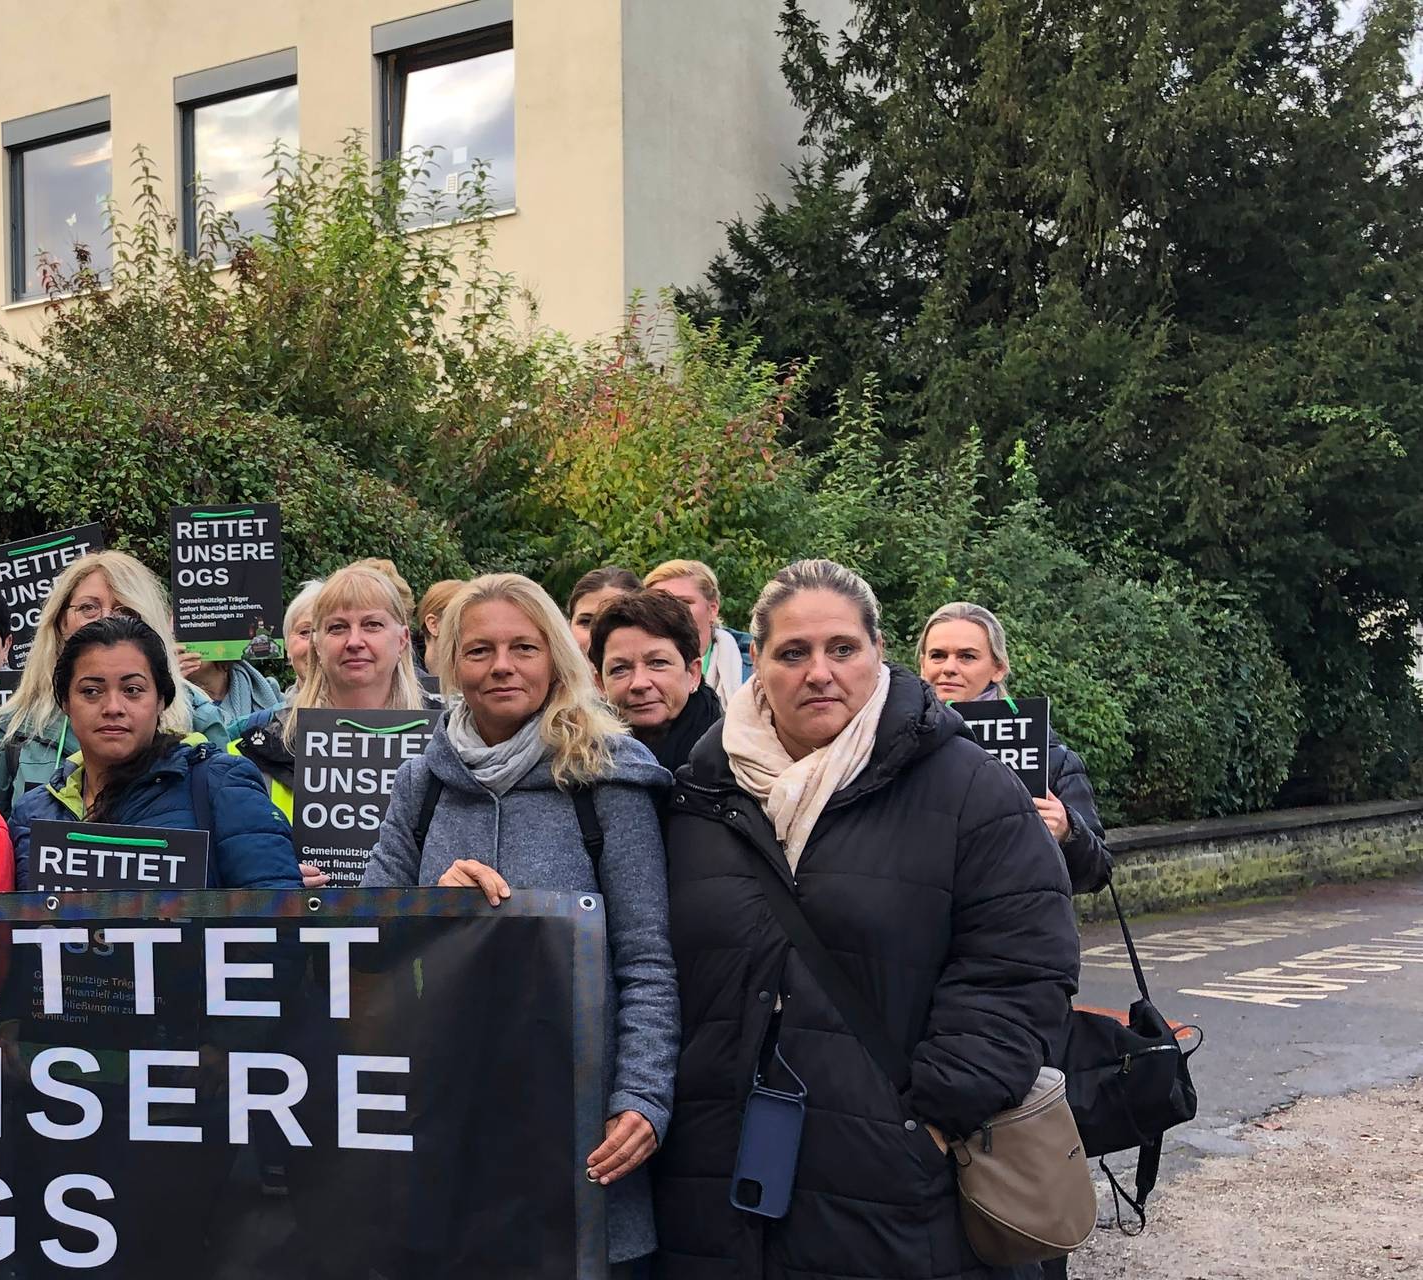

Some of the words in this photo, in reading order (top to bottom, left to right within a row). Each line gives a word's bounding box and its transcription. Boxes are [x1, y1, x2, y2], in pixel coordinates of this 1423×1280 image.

[177, 518, 269, 539] RETTET
[177, 542, 275, 563] UNSERE
[177, 567, 230, 587] OGS
[304, 767, 398, 795] UNSE
[301, 802, 381, 831] OGS
[39, 846, 186, 884] RETTET
